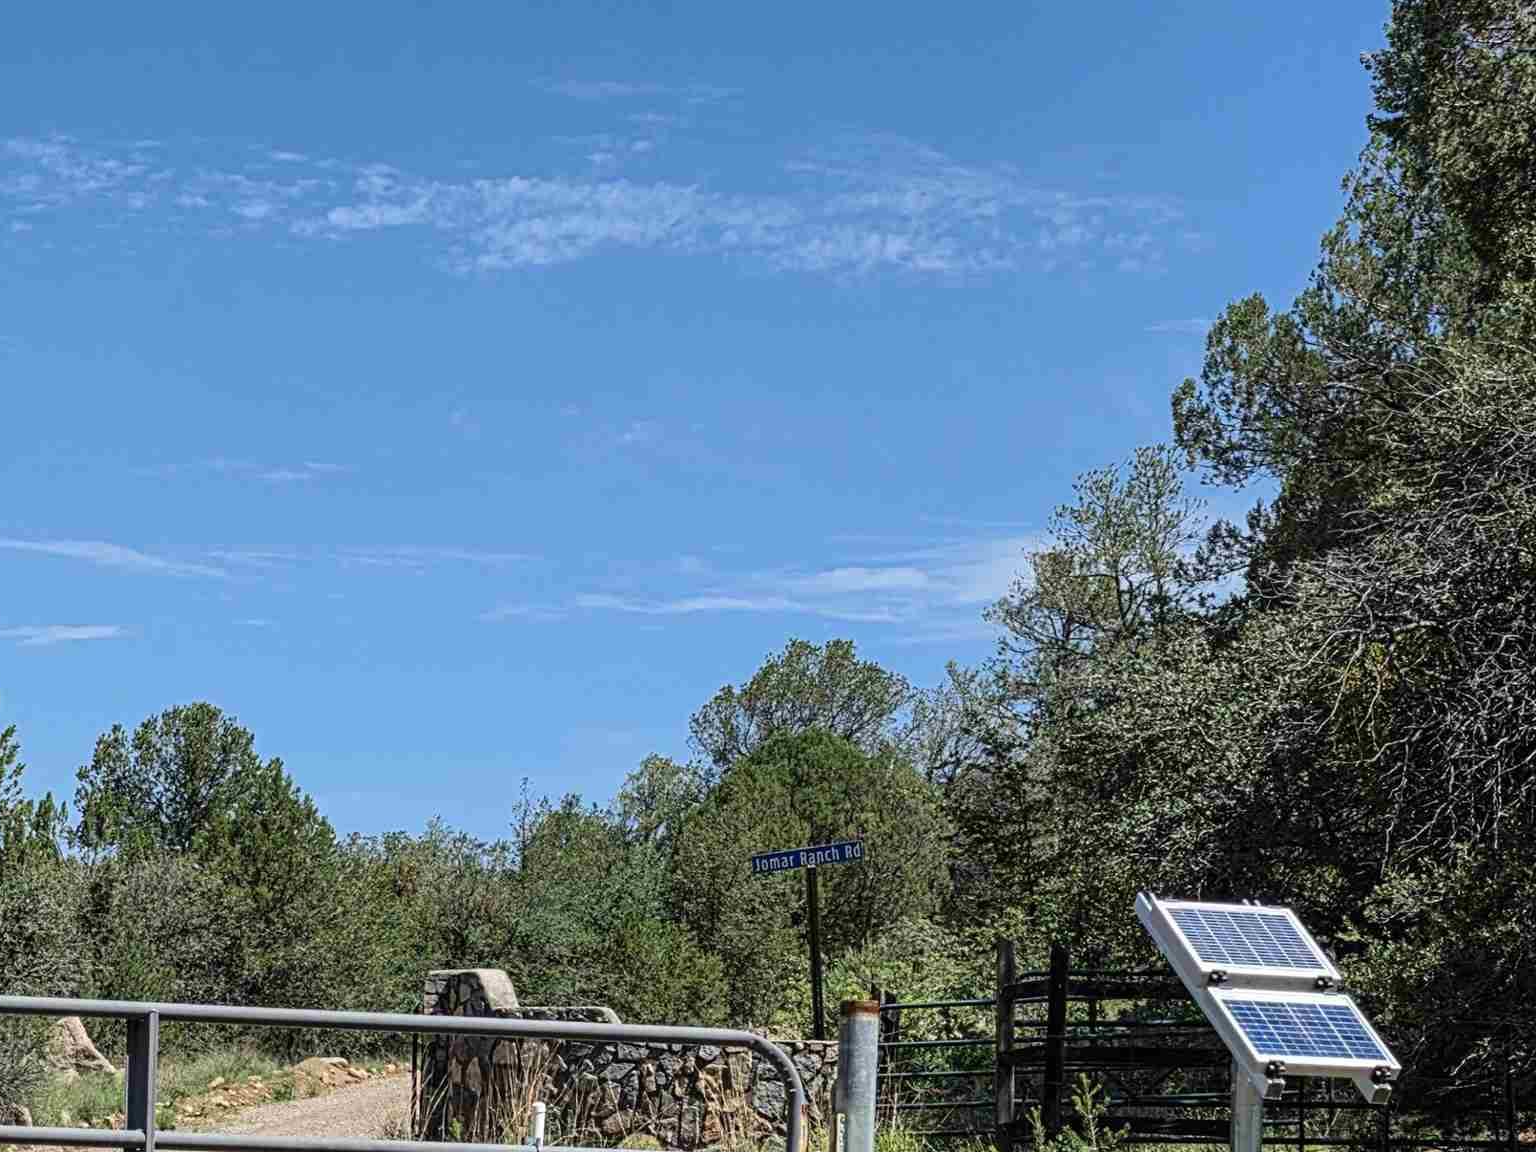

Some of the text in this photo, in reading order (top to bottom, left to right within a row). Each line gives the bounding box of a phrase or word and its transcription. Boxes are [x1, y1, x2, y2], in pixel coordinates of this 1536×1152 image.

[755, 843, 861, 871] Jomar Ranch Rd
